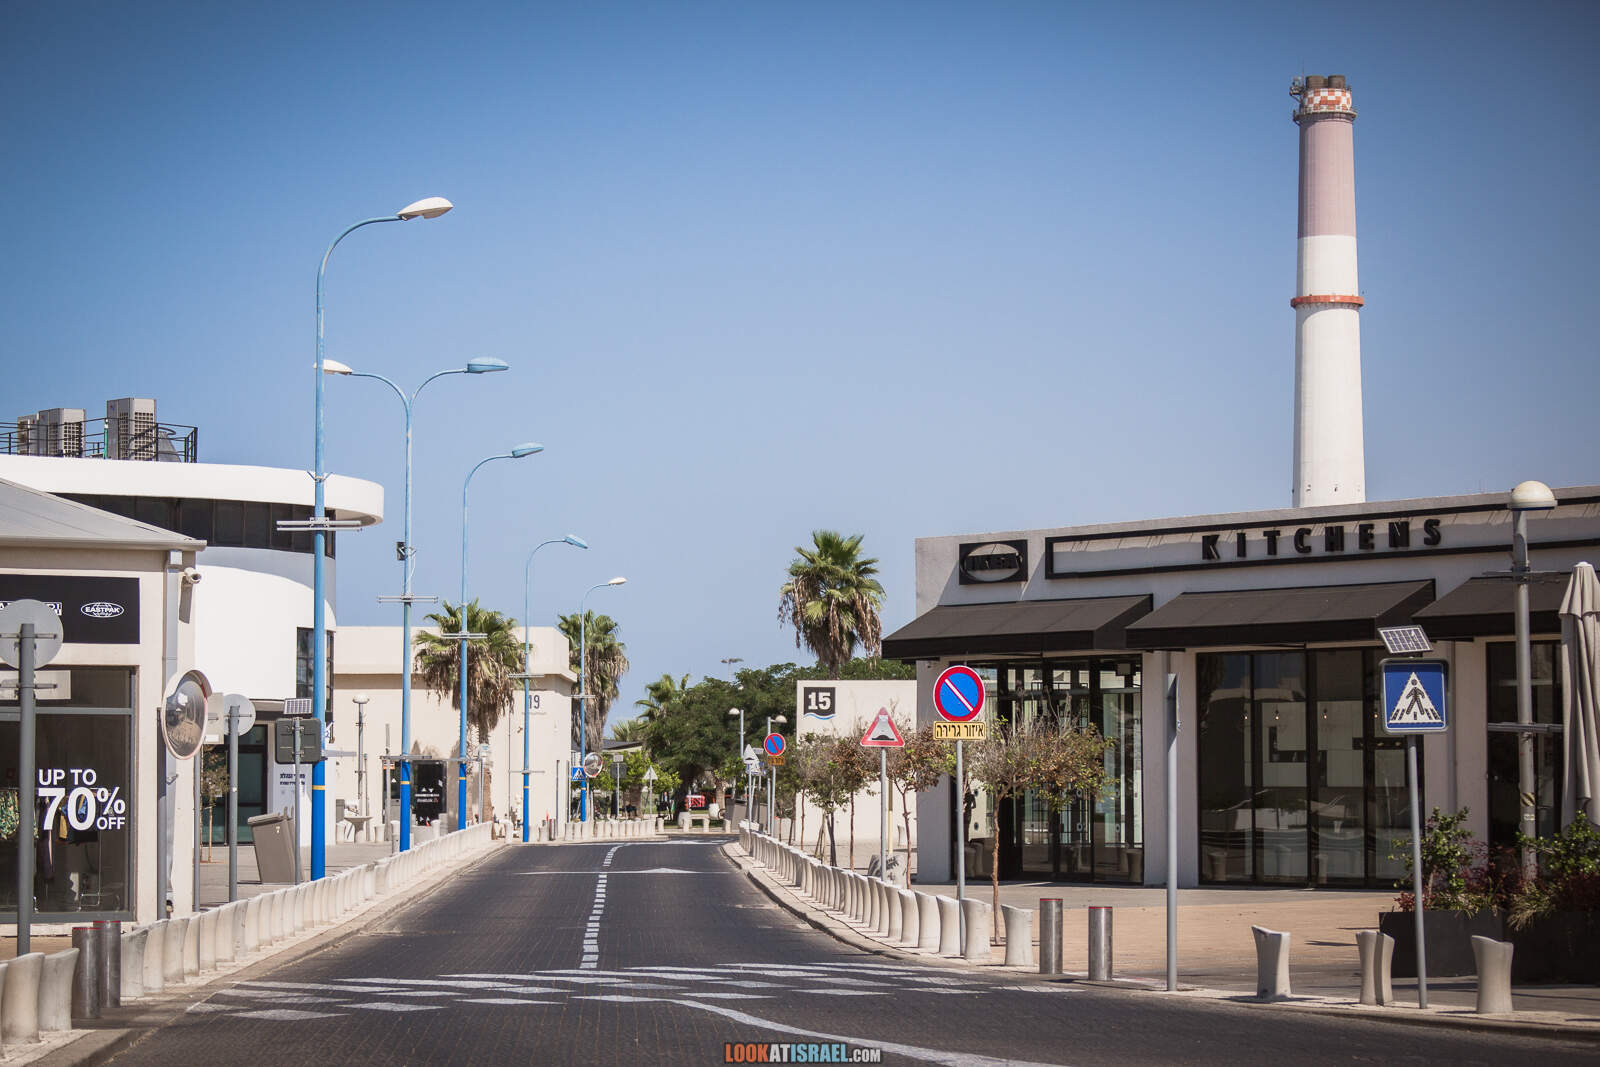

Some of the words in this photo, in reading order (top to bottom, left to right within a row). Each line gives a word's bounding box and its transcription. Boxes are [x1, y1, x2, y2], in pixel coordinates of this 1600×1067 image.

[1201, 518, 1441, 560] KITCHENS
[808, 691, 831, 711] 15
[936, 724, 961, 737] גרירה
[964, 724, 984, 737] איזור
[38, 769, 65, 786] UP
[71, 769, 97, 786] TO
[38, 786, 126, 830] 70%
[97, 816, 126, 830] OFF
